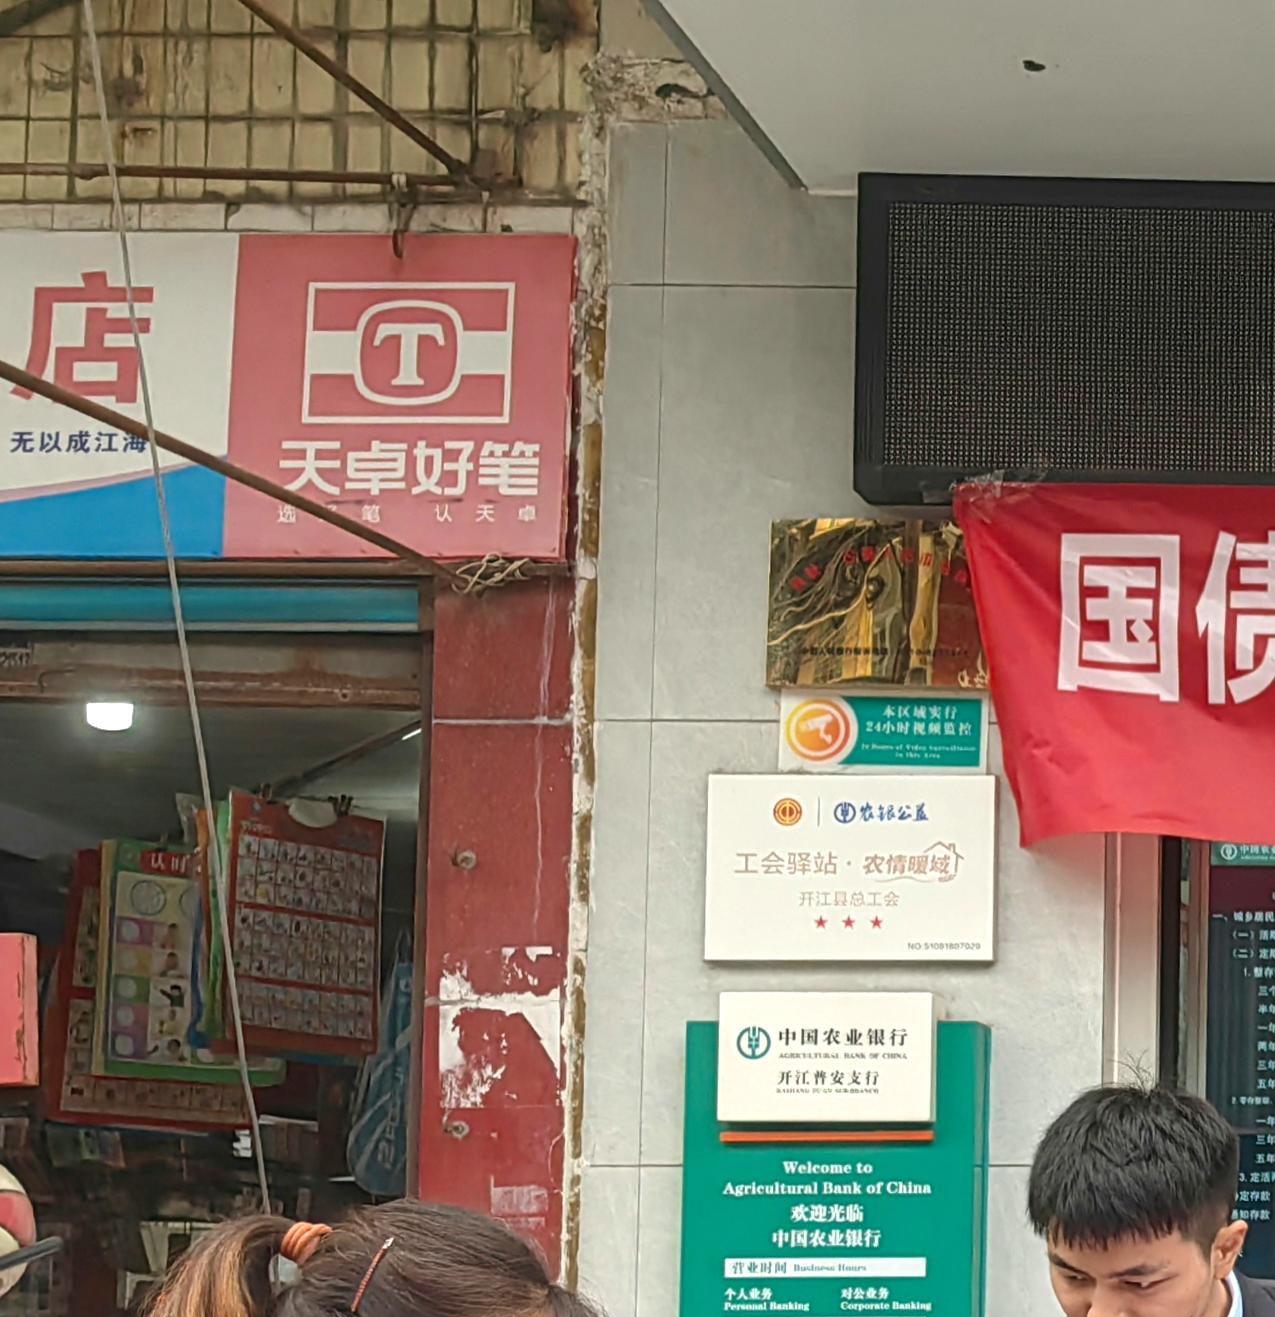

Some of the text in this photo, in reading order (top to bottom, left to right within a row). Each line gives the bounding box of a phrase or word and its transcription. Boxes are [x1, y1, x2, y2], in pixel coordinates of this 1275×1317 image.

[10, 271, 155, 405] 店
[10, 430, 149, 455] 无以成江海
[278, 440, 541, 497] 天卓好笔
[882, 704, 958, 720] 本区域实行
[865, 721, 973, 737] 24小时视频监控
[798, 890, 900, 908] 开江县总工会
[778, 1027, 908, 1047] 中国农业银行
[777, 1069, 880, 1086] 开江普安支行
[1255, 1134, 1275, 1145] 三年
[1255, 1153, 1275, 1164] 五年
[783, 1161, 873, 1175] Welcome to
[722, 1181, 932, 1195] Agricultural Bank of China
[790, 1203, 864, 1223] 欢迎光临
[771, 1228, 882, 1248] 中国农业银行
[732, 1261, 788, 1274] 营业时间
[724, 1287, 889, 1301] 个人业务 对公业务
[724, 1301, 932, 1312] Personal Banking Corporate Banking
